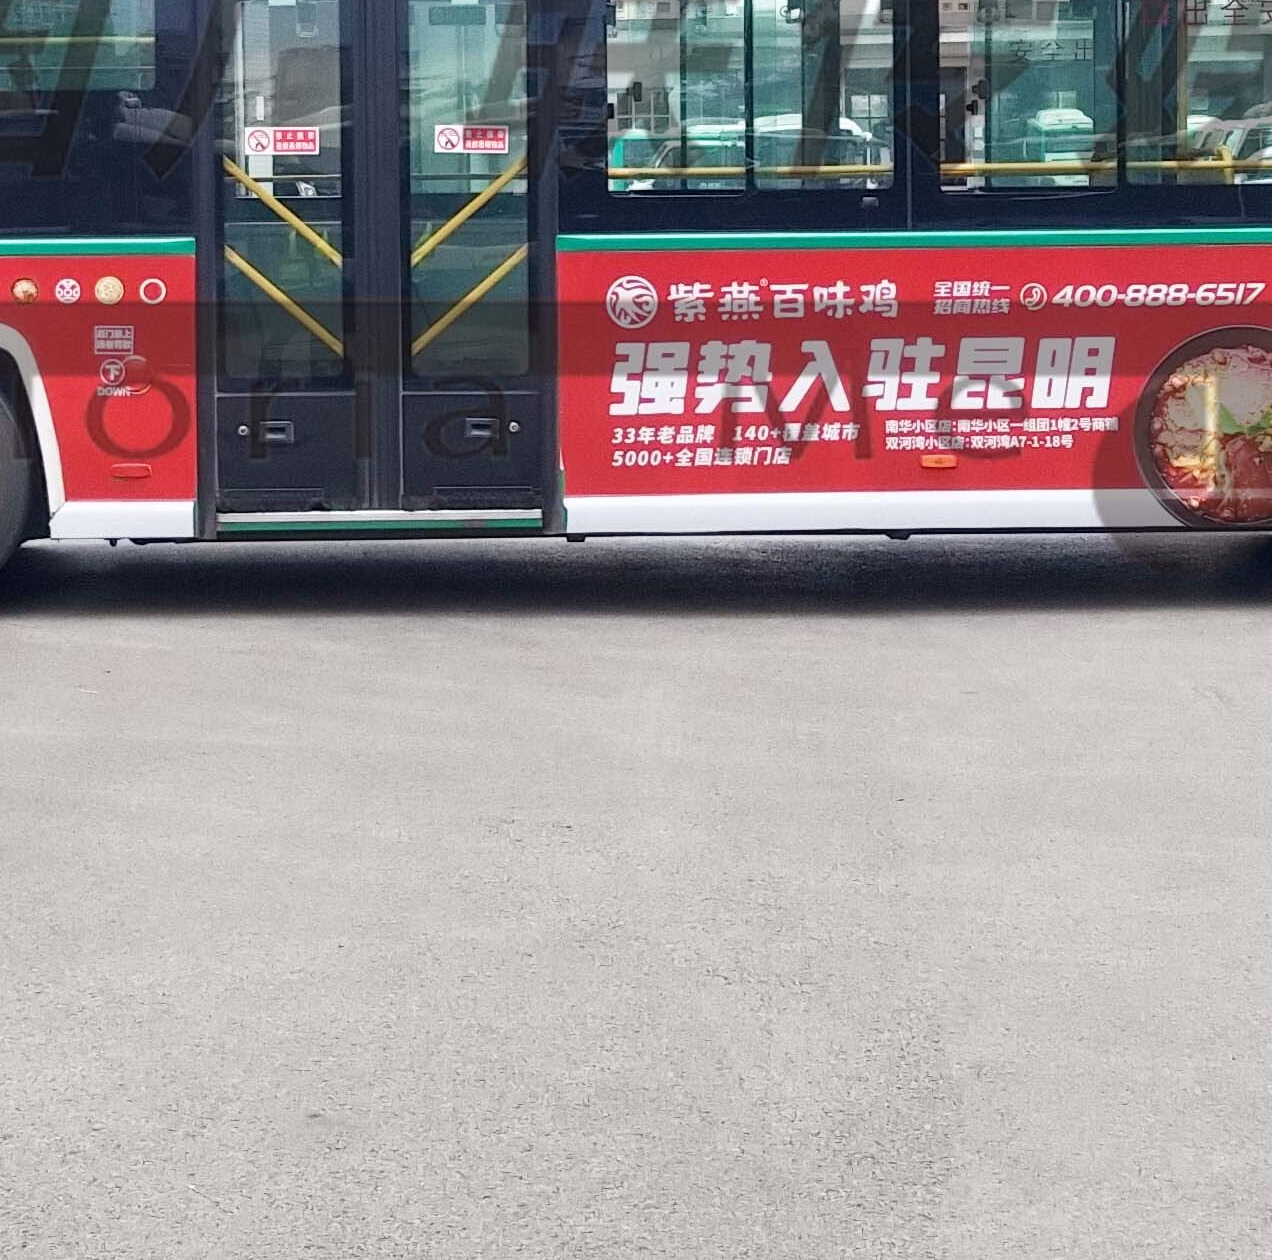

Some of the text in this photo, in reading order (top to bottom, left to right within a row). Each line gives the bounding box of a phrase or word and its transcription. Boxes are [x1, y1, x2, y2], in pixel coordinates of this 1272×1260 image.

[933, 281, 1011, 298] 全国统一
[1052, 282, 1266, 308] 400-888-6517
[609, 336, 1117, 416] 强势入驻昆明
[611, 424, 716, 445] 33年老品牌
[612, 447, 793, 467] 5000+全国连锁门店
